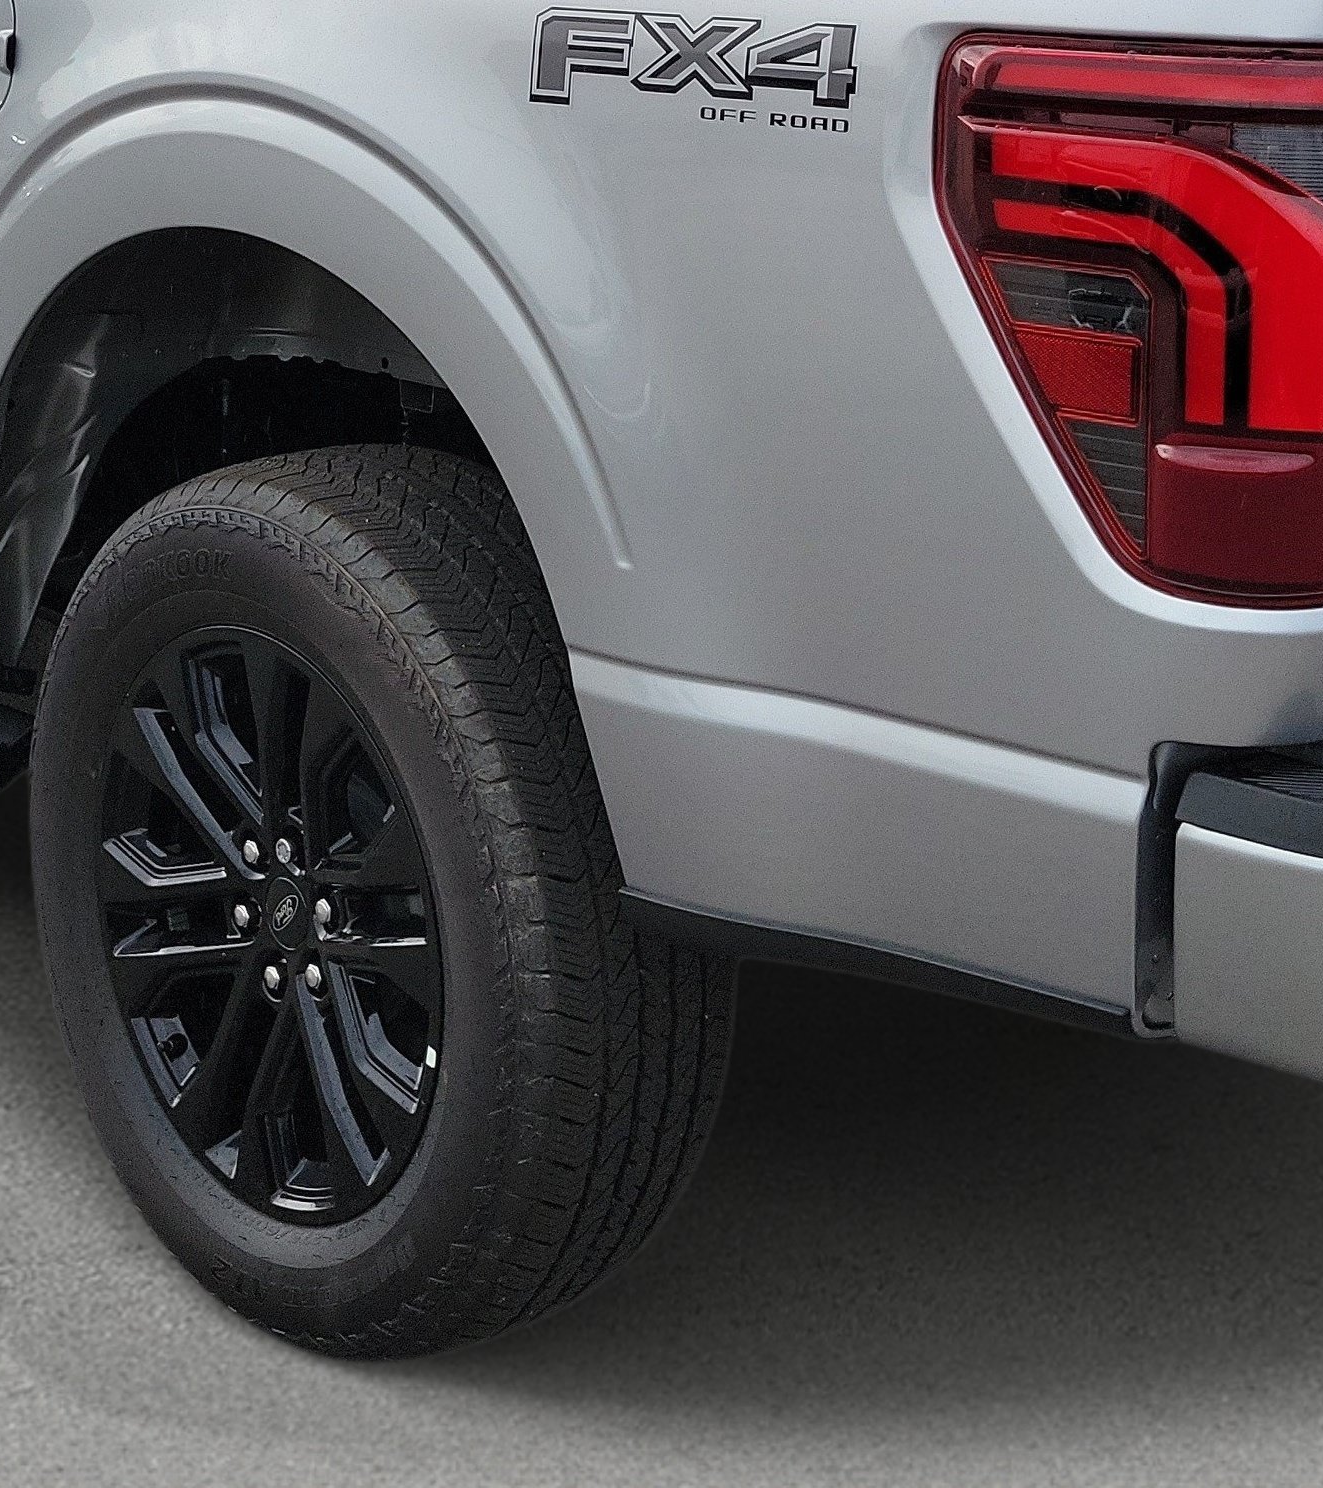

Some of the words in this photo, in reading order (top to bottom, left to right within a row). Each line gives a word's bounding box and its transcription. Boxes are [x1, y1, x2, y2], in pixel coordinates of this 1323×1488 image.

[529, 6, 858, 109] FX4
[699, 106, 757, 122] OFF
[769, 112, 850, 133] ROAD
